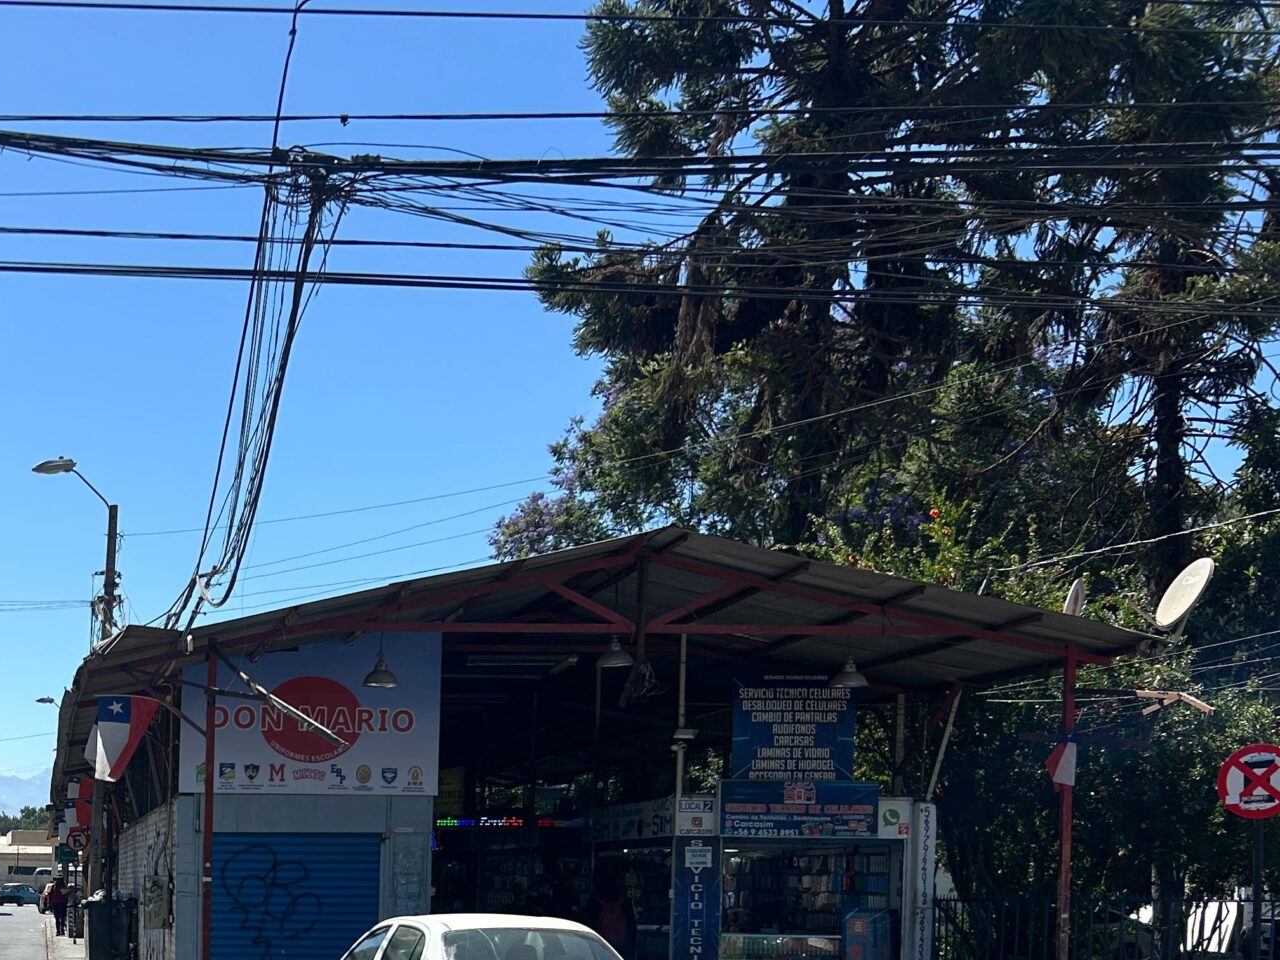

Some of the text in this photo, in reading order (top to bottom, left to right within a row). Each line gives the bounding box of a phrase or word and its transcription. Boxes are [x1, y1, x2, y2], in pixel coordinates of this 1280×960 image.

[739, 688, 851, 699] SERVICIO TECNICO CELULARES
[794, 700, 804, 711] DE
[805, 700, 847, 711] CELULARES
[214, 705, 415, 734] DON MARIO
[751, 712, 838, 723] CAMBIO DE PANTALLAS
[772, 723, 816, 734] AUDIFONOS
[774, 735, 814, 746] CARCASAS
[270, 739, 310, 762] UNIFORMES
[757, 747, 830, 758] LAMINAS DE VIDRIO
[751, 759, 835, 770] LAMINAS DE HIDROGEL
[268, 763, 286, 782] M
[680, 801, 712, 812] LOCAL 2
[733, 820, 774, 828] Carcasim
[734, 828, 749, 836] +56
[690, 840, 704, 910] SVICIO
